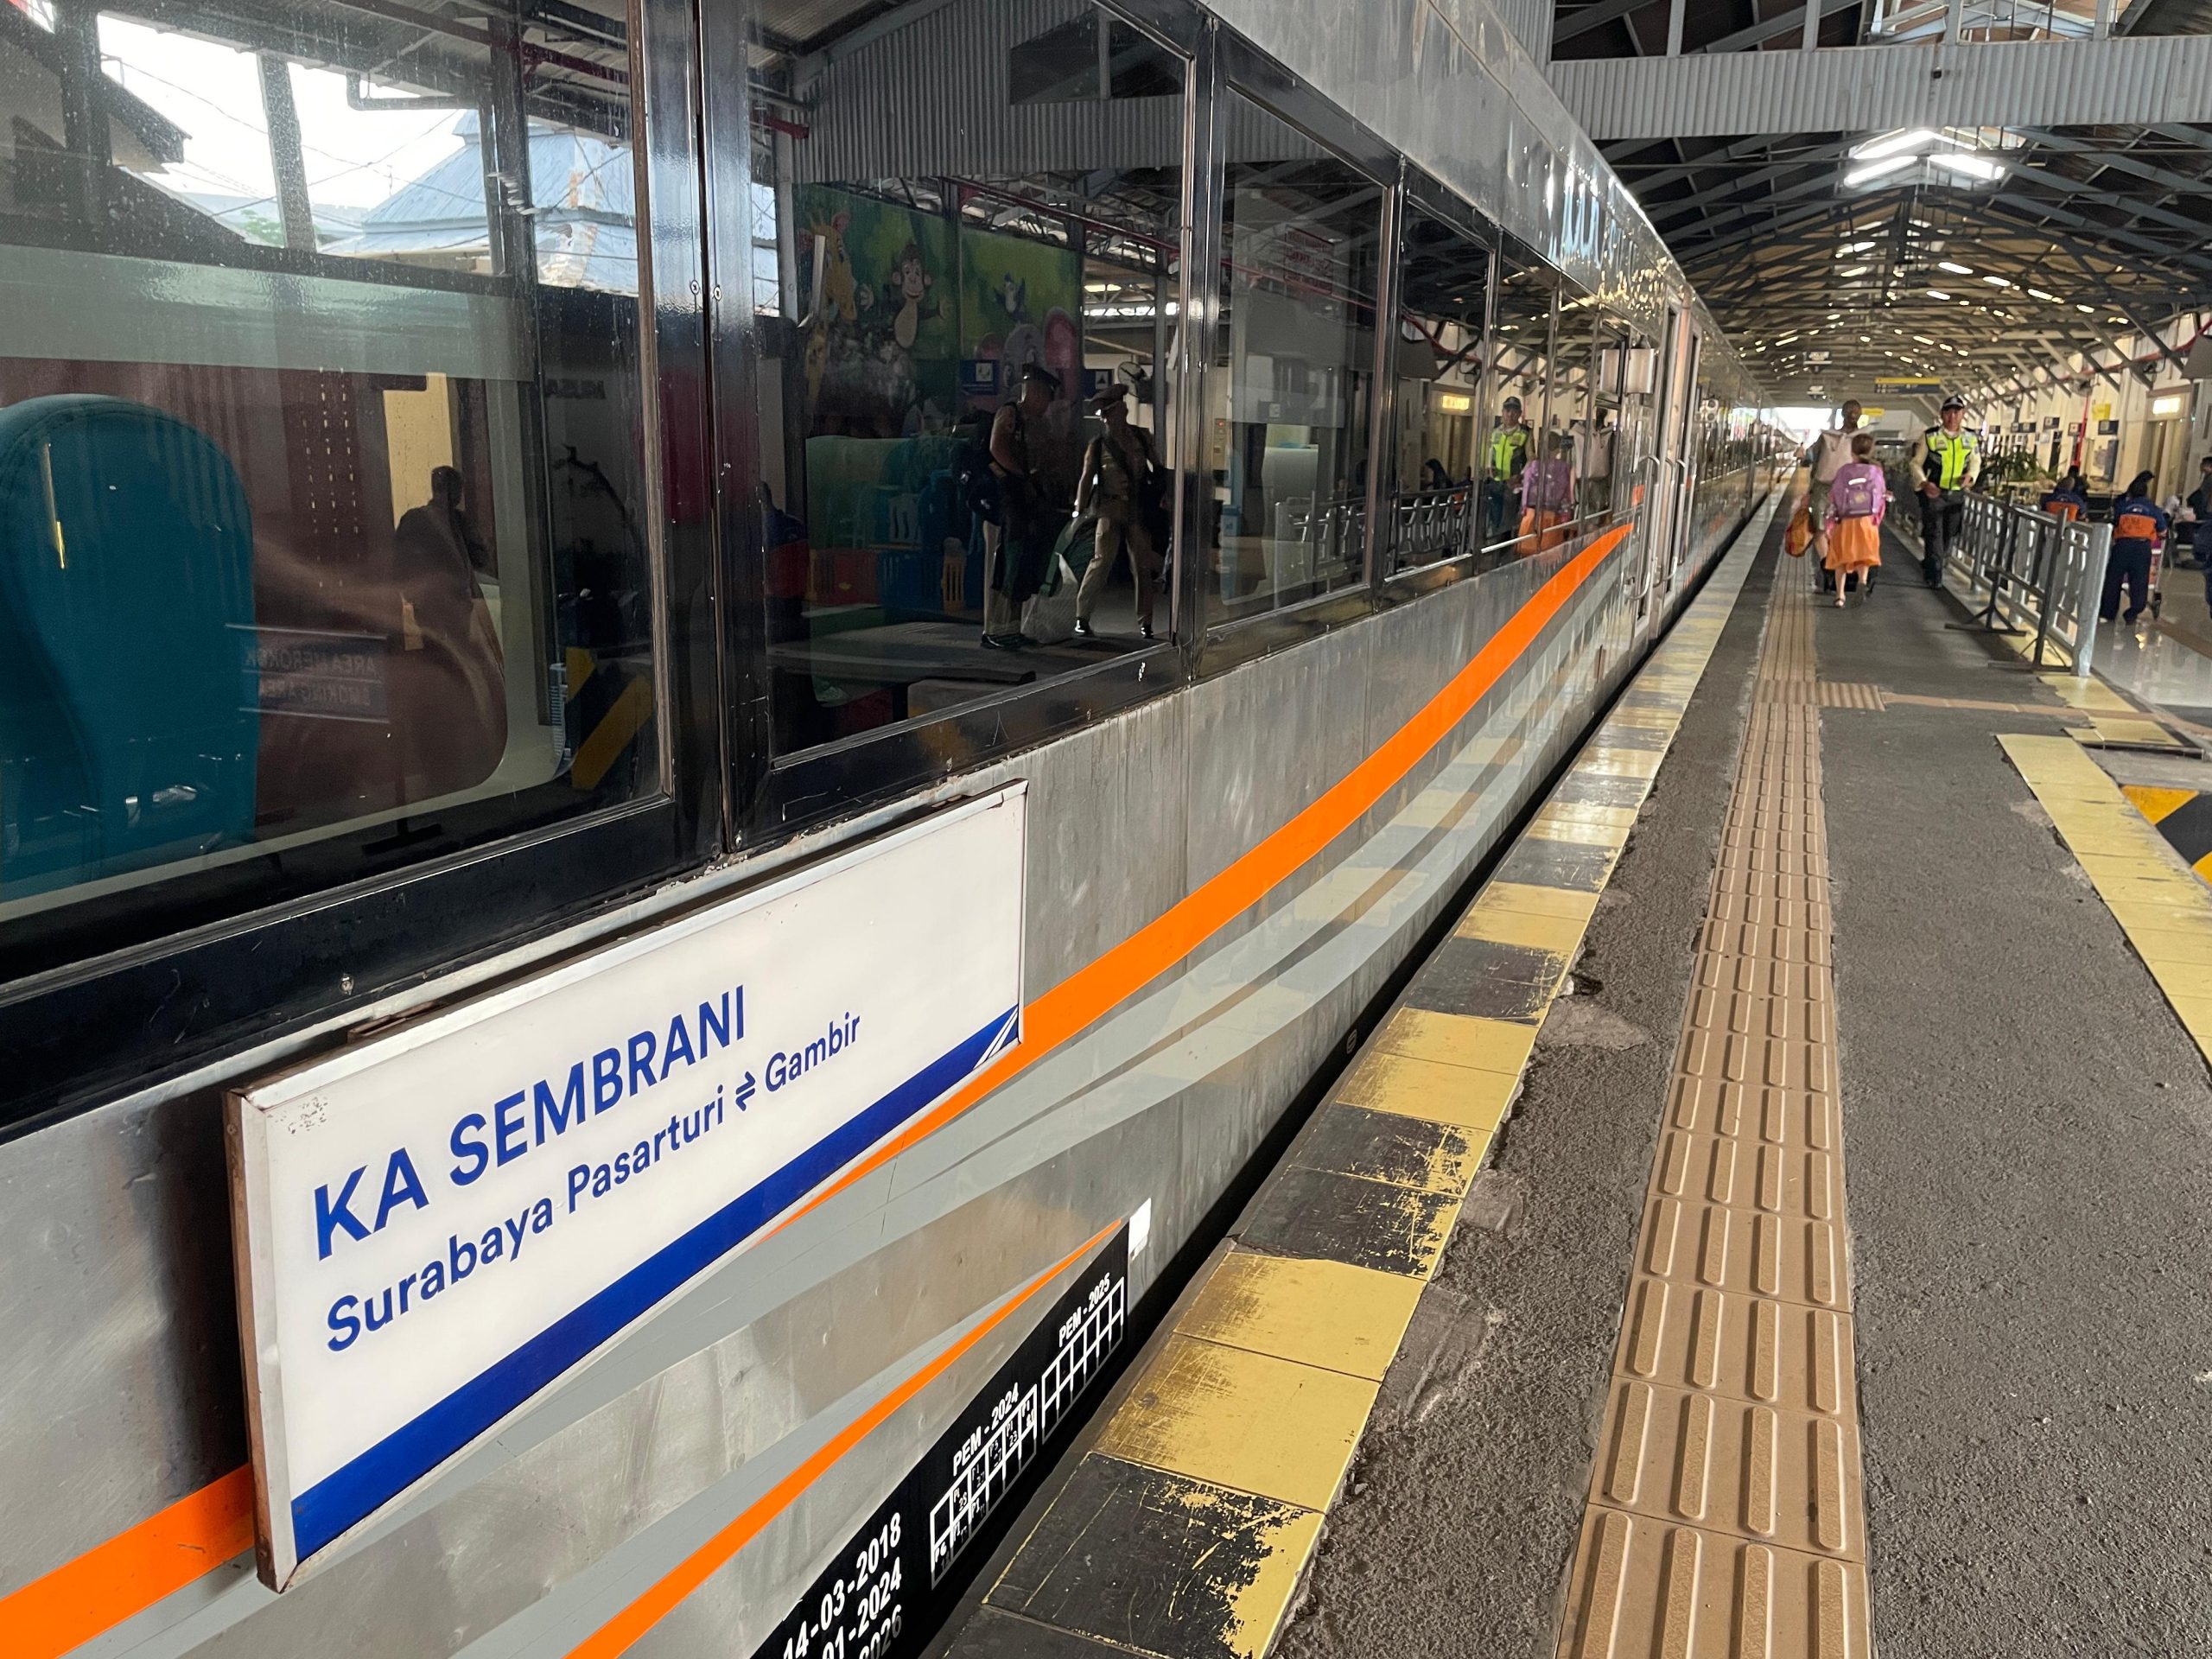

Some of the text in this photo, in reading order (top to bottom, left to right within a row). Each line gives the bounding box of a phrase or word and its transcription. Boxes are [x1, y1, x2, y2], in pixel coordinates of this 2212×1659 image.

[312, 984, 745, 1262] KA SEMBRANI
[326, 1012, 861, 1352] Surabaya Pasarturi Gambir
[1058, 1306, 1082, 1348] PEM
[1089, 1272, 1110, 1313] 2025
[952, 1426, 982, 1477] PEM
[991, 1382, 1019, 1431] 2024
[783, 1512, 901, 1659] 14-03-2018
